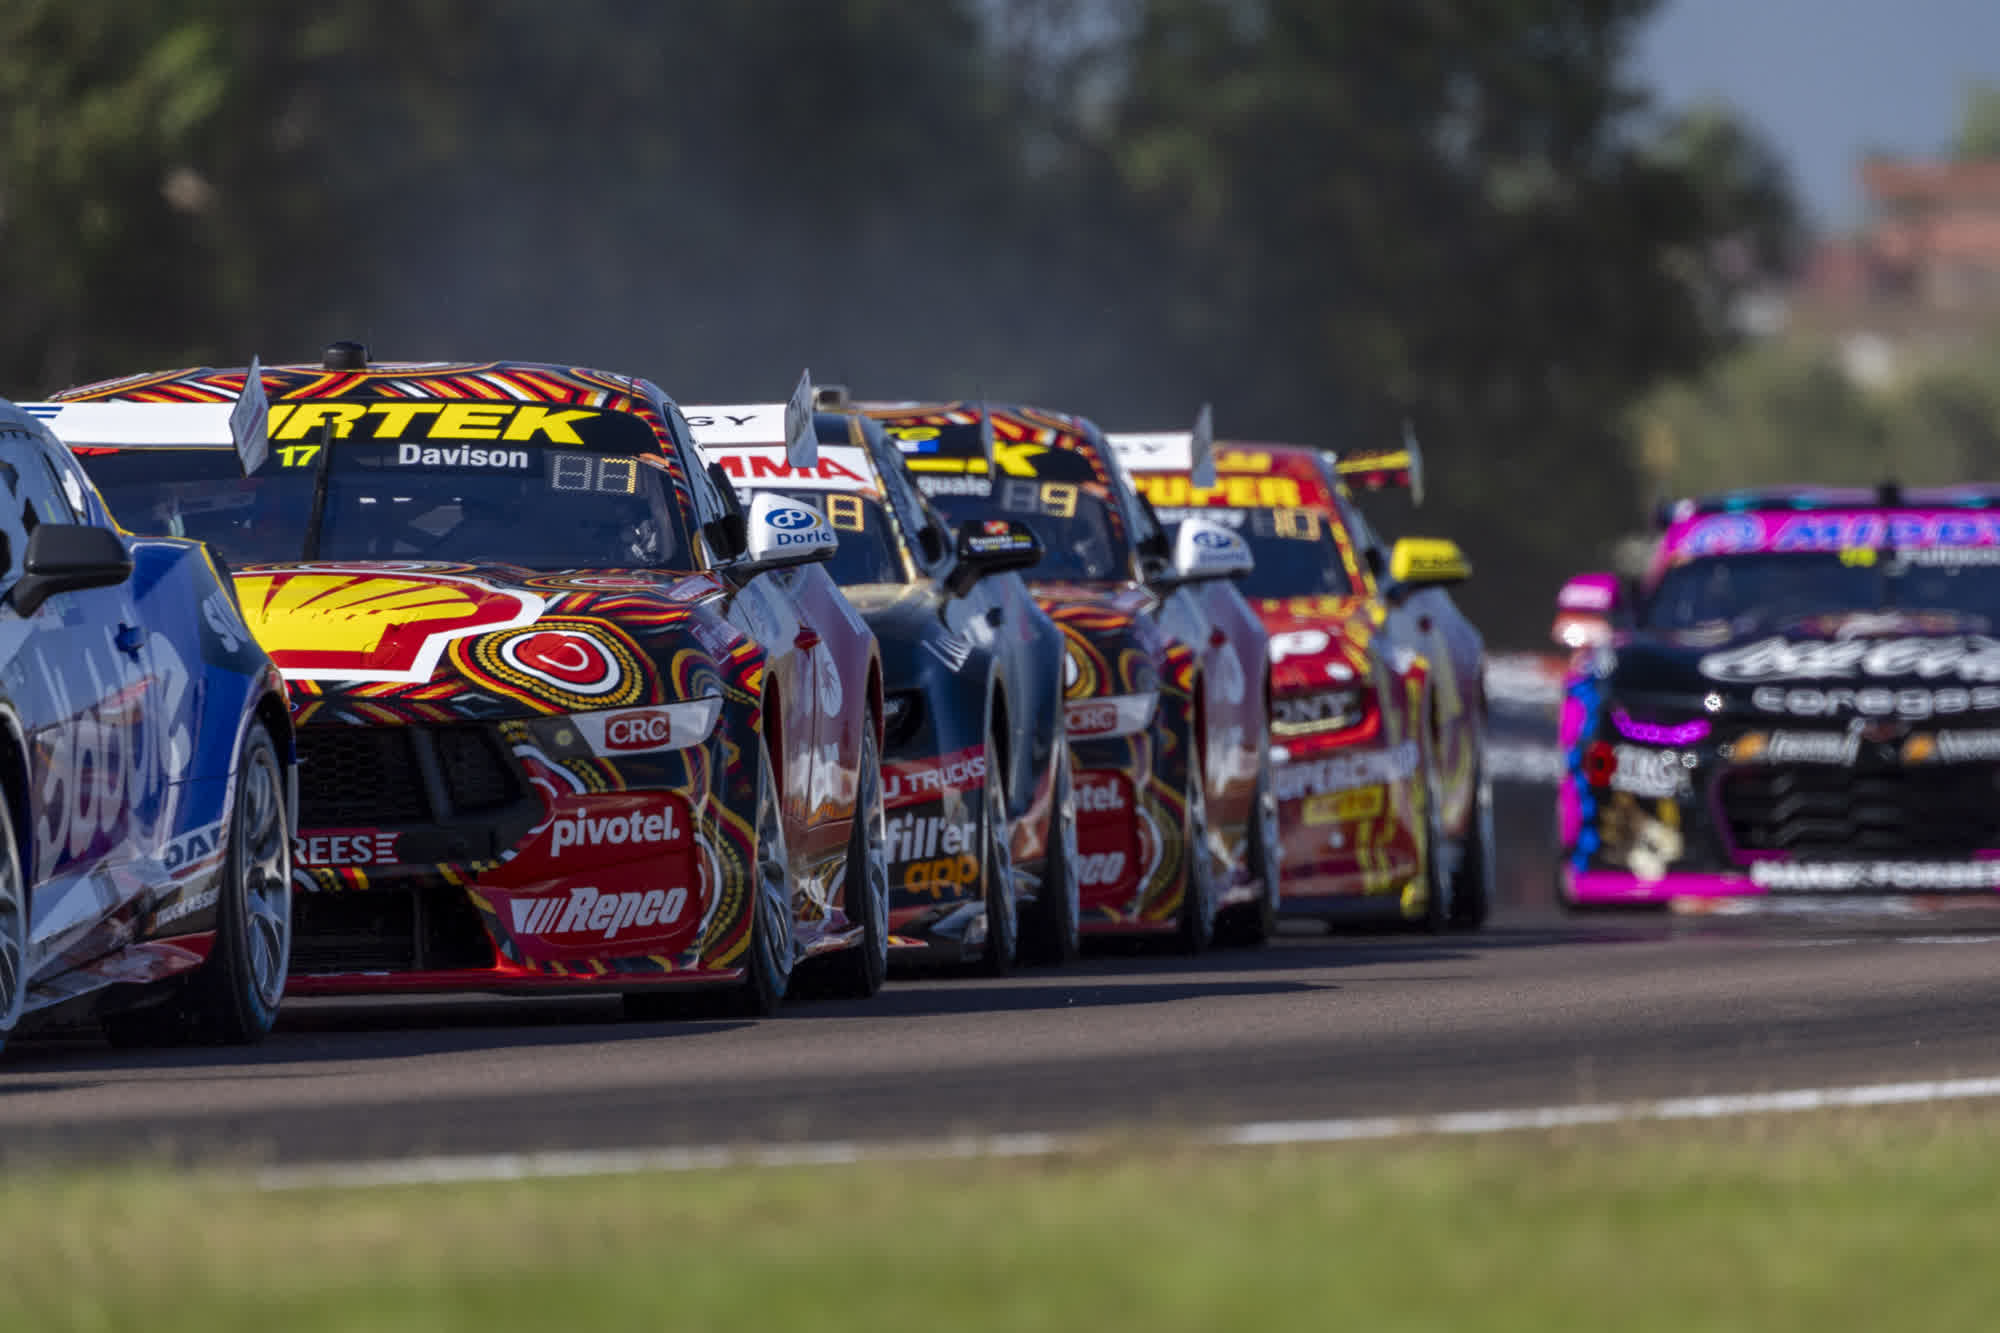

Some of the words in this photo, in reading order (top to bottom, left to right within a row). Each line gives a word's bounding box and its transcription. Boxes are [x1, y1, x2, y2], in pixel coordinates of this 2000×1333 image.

[276, 444, 321, 467] 17
[399, 444, 528, 468] Davison
[776, 530, 832, 545] Doric
[608, 717, 667, 743] CRC
[904, 756, 985, 792] TRUCKS
[904, 855, 979, 899] app
[555, 888, 688, 938] Repco
